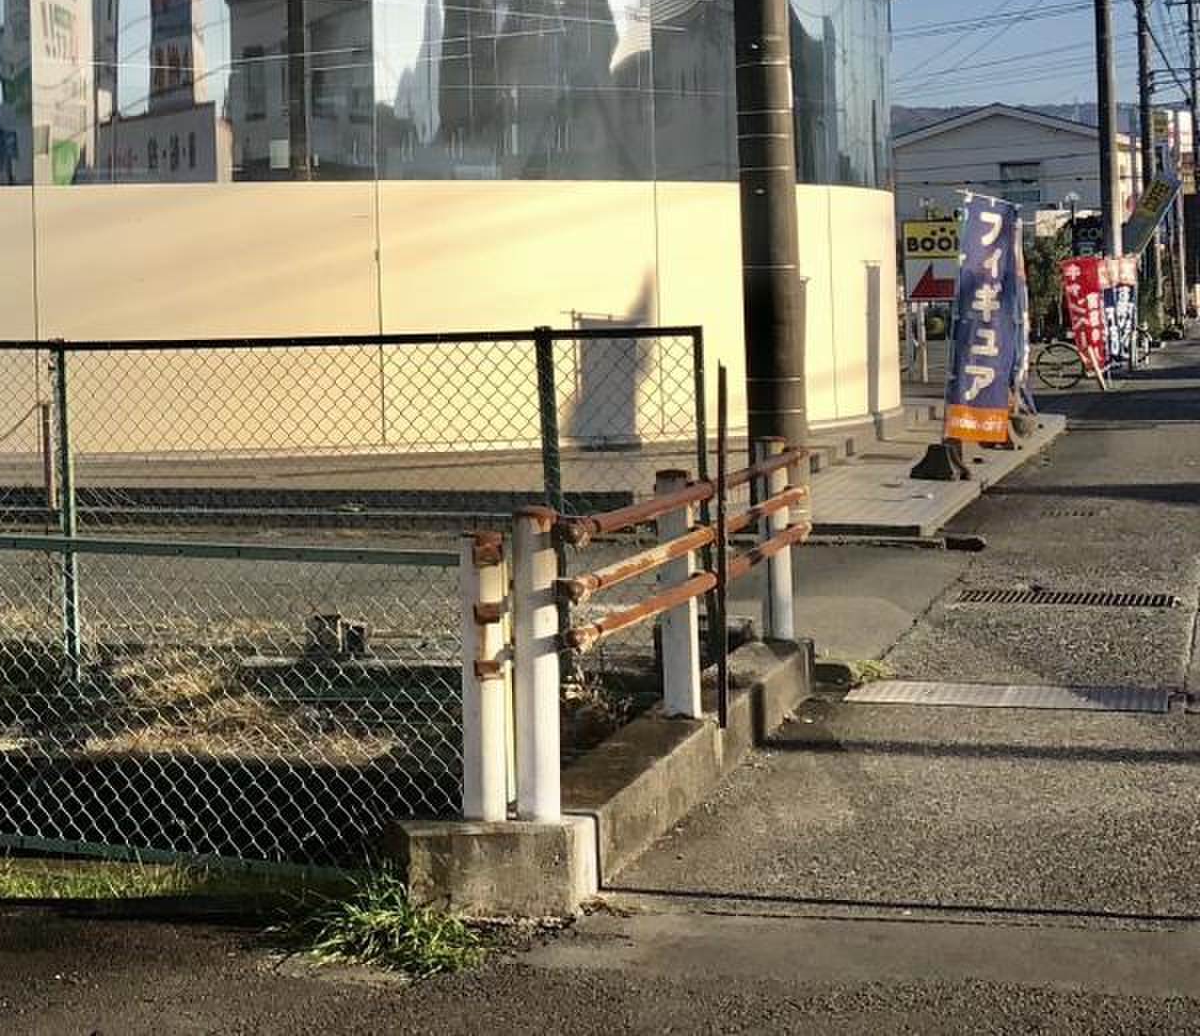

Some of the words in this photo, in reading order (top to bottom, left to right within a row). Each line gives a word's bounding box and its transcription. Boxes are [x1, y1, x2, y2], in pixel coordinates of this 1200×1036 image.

[964, 211, 1003, 401] フィギュア
